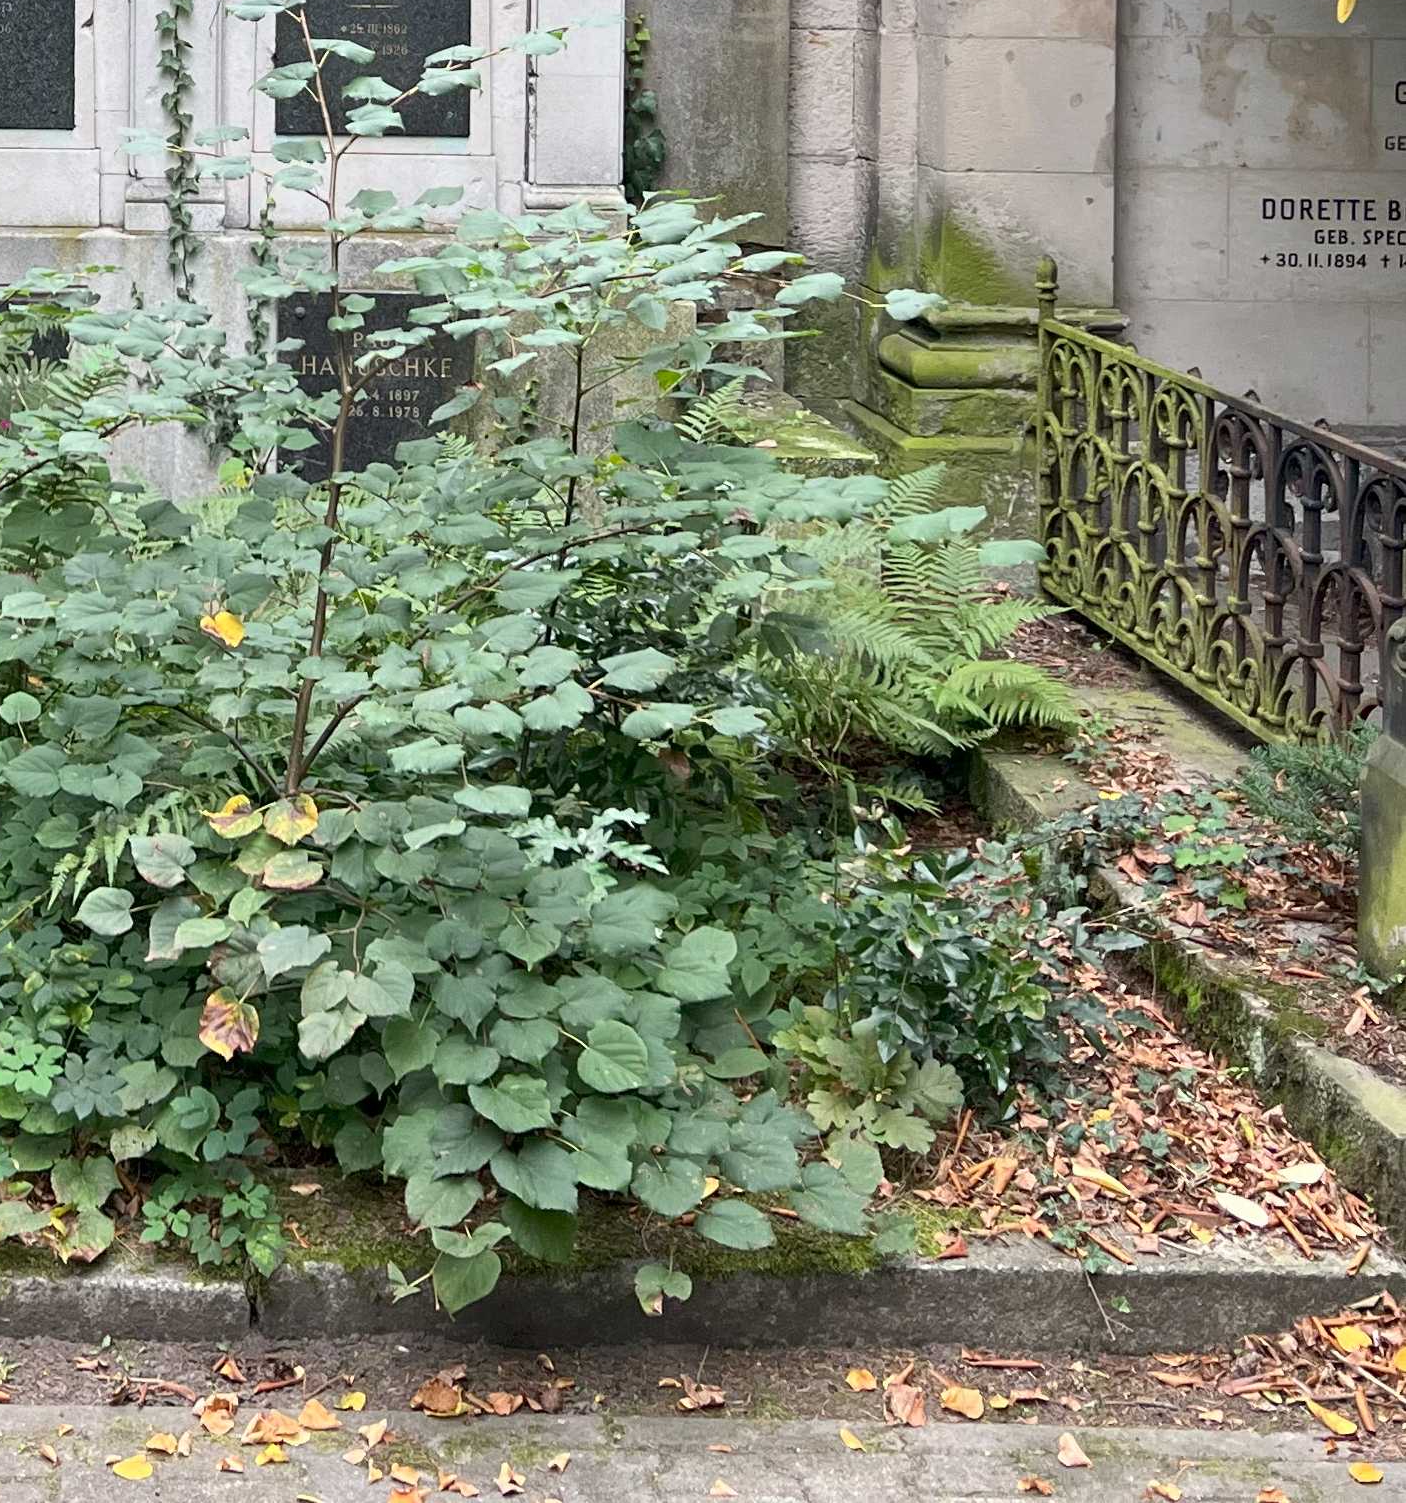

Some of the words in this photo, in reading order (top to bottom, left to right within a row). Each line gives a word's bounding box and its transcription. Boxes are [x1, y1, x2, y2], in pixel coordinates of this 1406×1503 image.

[1262, 198, 1377, 221] DORETTE
[1314, 229, 1356, 245] GEB.
[389, 389, 420, 401] 1897
[389, 406, 420, 419] 1978
